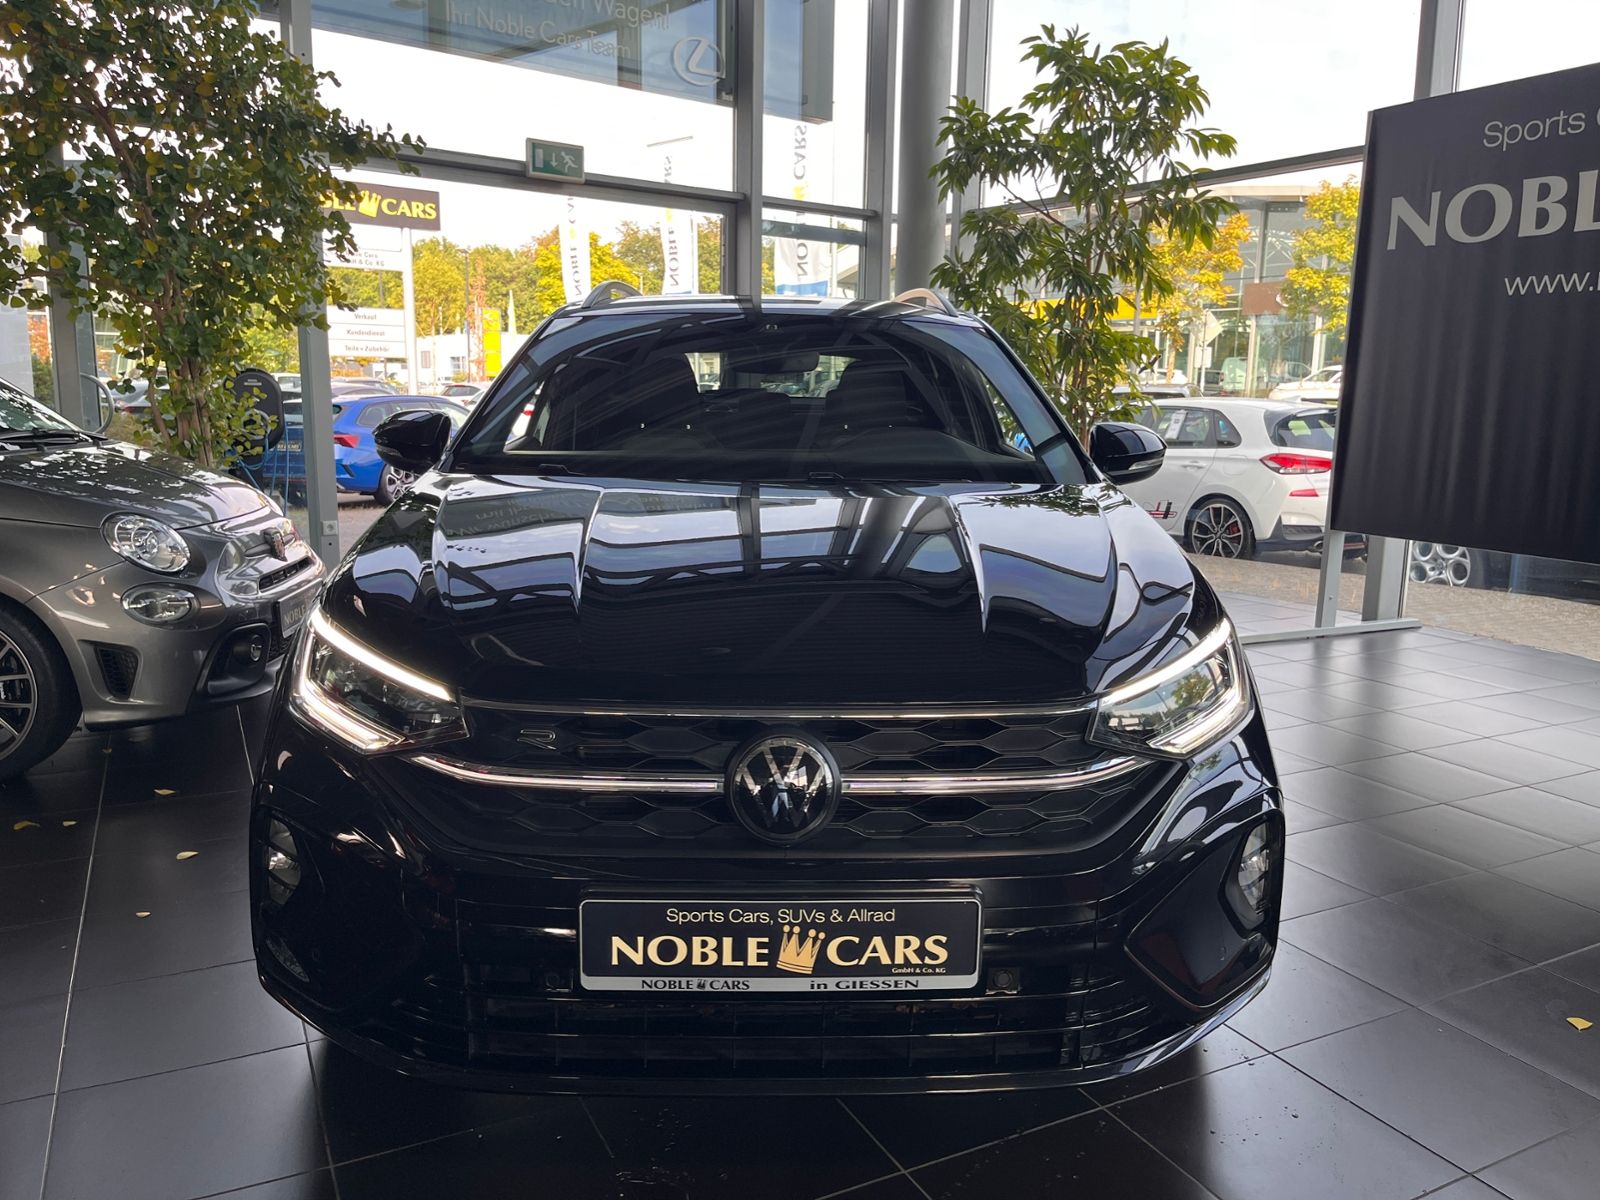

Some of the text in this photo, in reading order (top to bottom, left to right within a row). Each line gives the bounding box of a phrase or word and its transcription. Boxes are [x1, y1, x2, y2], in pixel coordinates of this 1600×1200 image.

[477, 7, 535, 39] Noble
[540, 20, 582, 49] Cars
[587, 29, 631, 59] Team
[1483, 110, 1586, 151] Sports
[380, 198, 437, 219] CARS
[1504, 271, 1600, 296] www.
[666, 908, 895, 925] Sports Cars, SUVs & Allrad
[611, 934, 949, 967] NOBLE CARS
[641, 979, 919, 990] NOBLE CARS in GIESSEN
